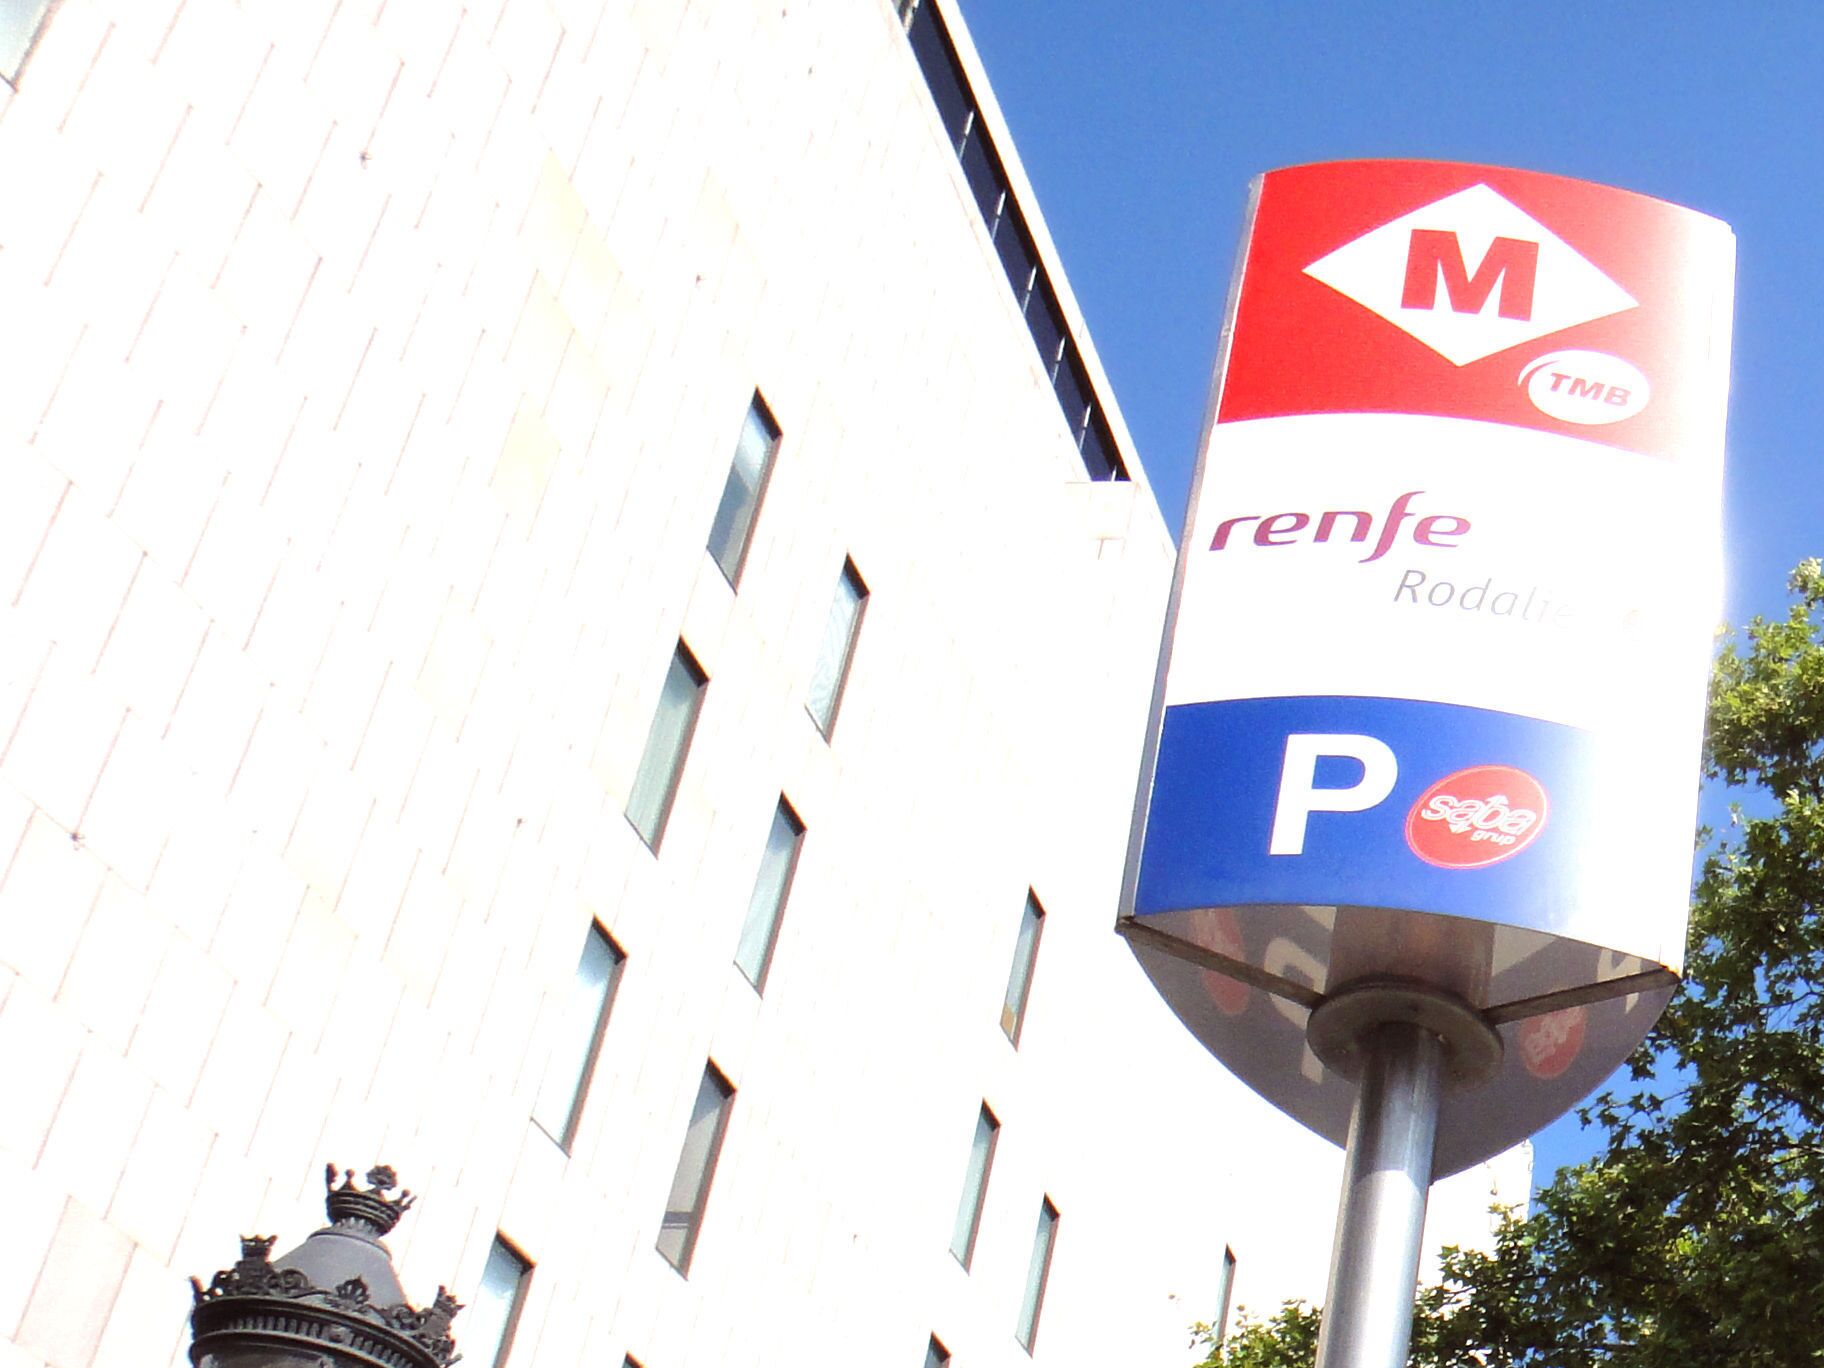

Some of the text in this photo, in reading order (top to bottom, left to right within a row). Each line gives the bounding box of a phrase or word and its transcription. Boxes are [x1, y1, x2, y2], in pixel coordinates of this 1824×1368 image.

[1400, 229, 1539, 321] M
[1548, 372, 1632, 408] TMB
[1209, 490, 1472, 563] renfe
[1269, 733, 1398, 855] P
[1421, 795, 1536, 836] saba
[1470, 830, 1516, 845] grup
